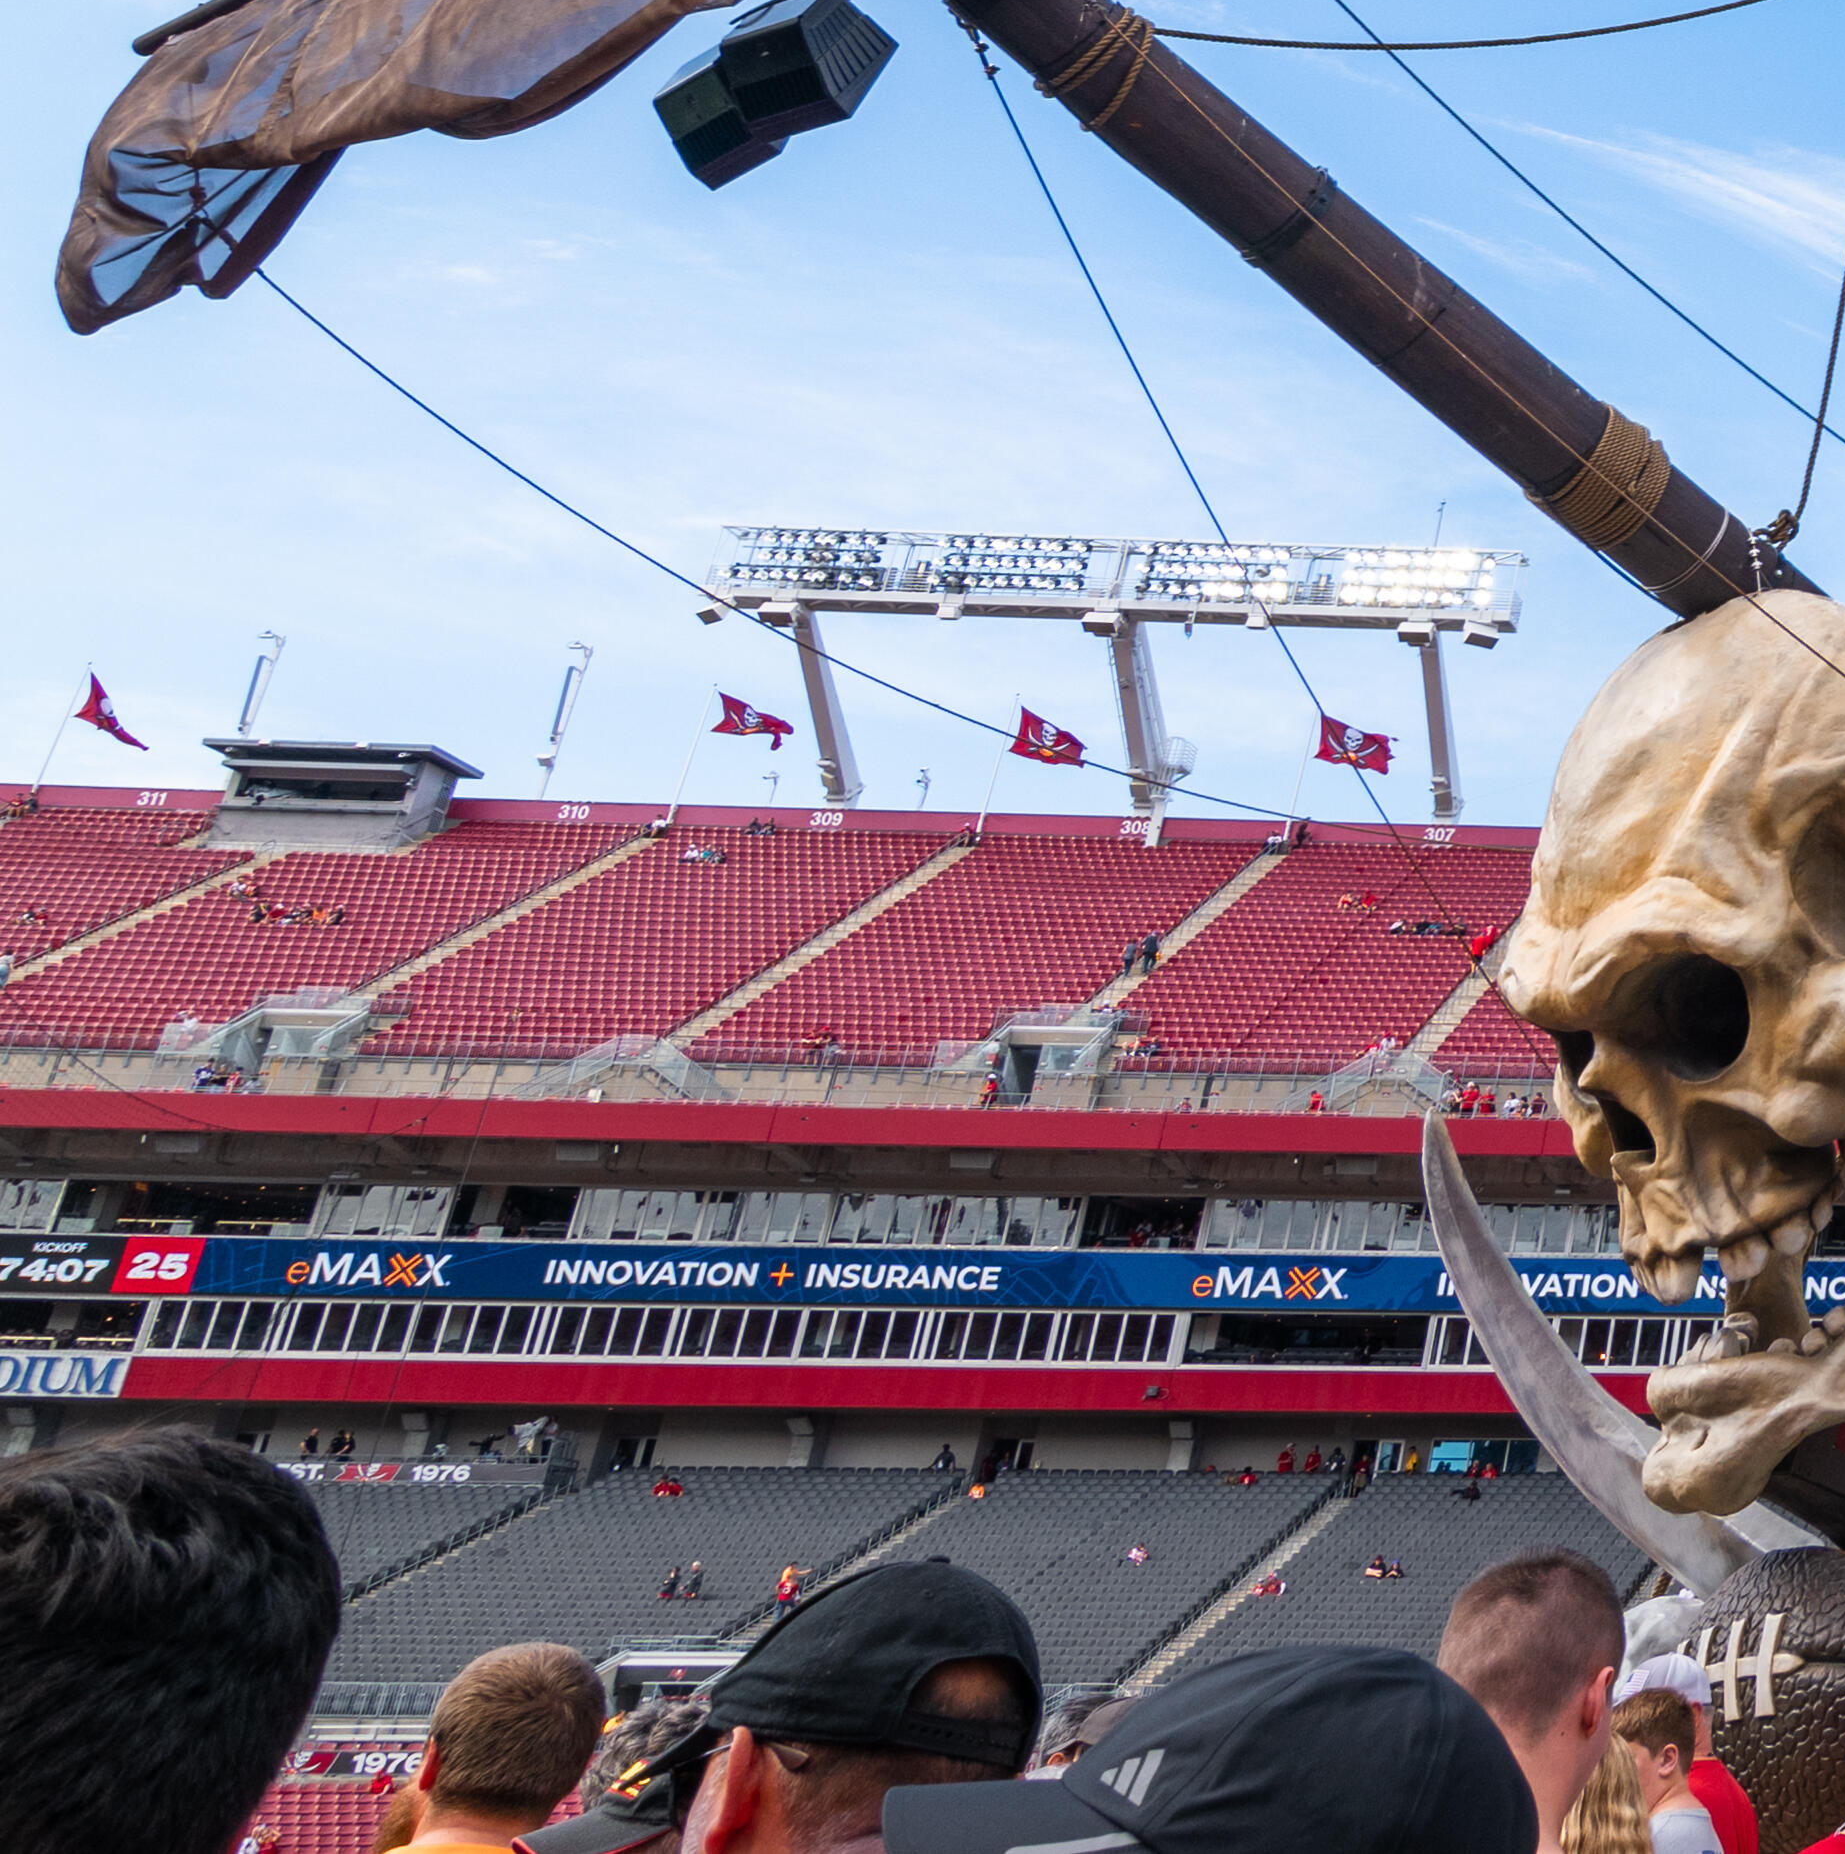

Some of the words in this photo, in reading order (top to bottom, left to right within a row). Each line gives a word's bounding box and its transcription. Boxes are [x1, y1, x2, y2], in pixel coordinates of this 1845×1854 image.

[136, 791, 168, 807] 311
[558, 803, 590, 821] 310
[810, 810, 844, 828] 309
[1424, 827, 1456, 843] 307
[32, 1241, 89, 1254] KICKOFF
[125, 1251, 190, 1281] 25
[285, 1252, 452, 1288] eMAXX
[543, 1259, 760, 1287] INNOVATION
[803, 1263, 1002, 1291] INSURANCE
[1192, 1265, 1349, 1300] eMAXX
[1436, 1271, 1640, 1298] IVATION
[276, 1462, 325, 1481] ST.
[410, 1463, 471, 1483] 1976
[352, 1751, 424, 1774] 1976
